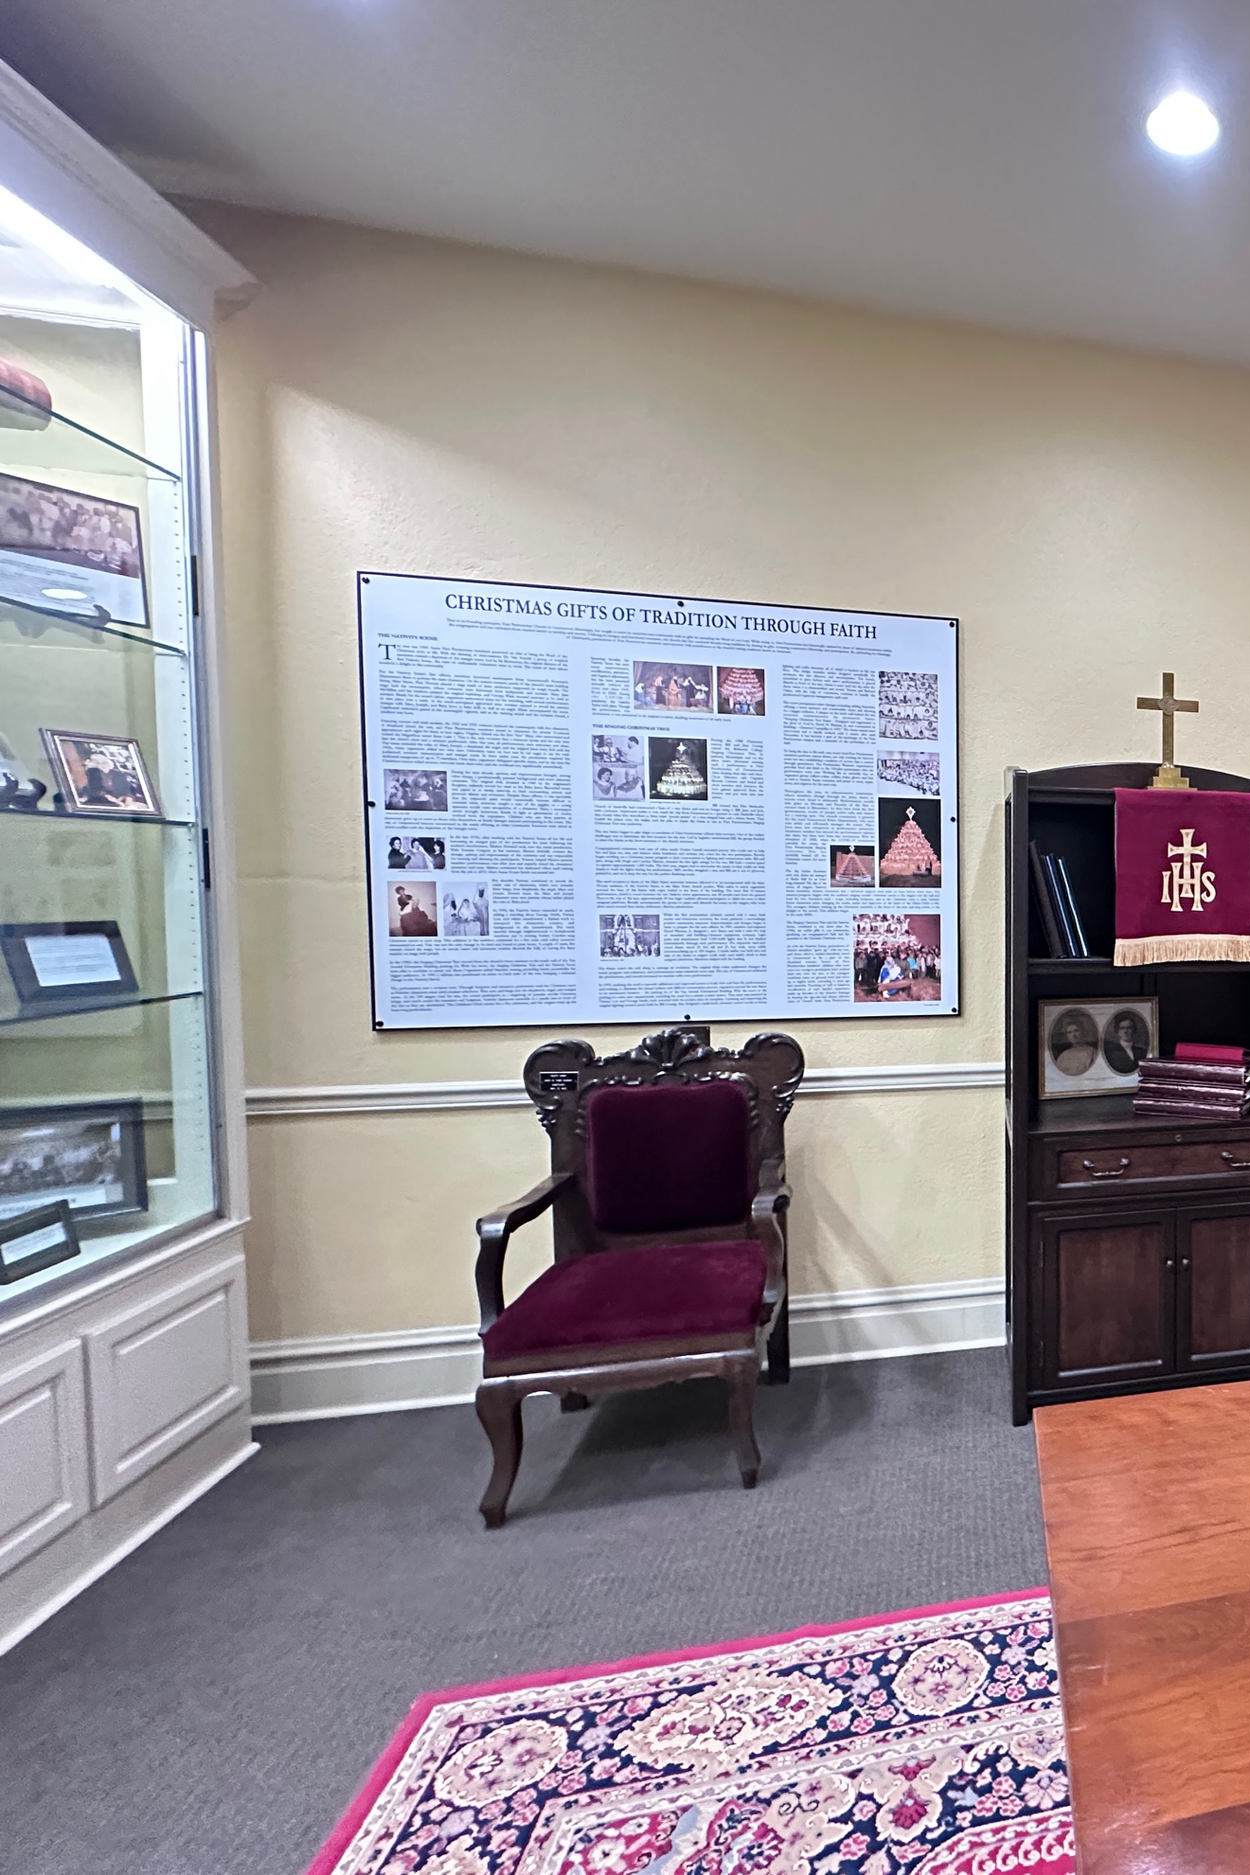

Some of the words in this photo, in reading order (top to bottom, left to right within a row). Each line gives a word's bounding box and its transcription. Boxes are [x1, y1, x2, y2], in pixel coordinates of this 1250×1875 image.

[445, 594, 553, 617] CHRISTMAS
[556, 602, 608, 621] GIFTS
[612, 606, 636, 622] OF
[639, 609, 738, 630] TRADITION
[741, 616, 826, 636] THROUGH
[829, 622, 878, 640] FAITH
[1161, 862, 1217, 912] IHS
